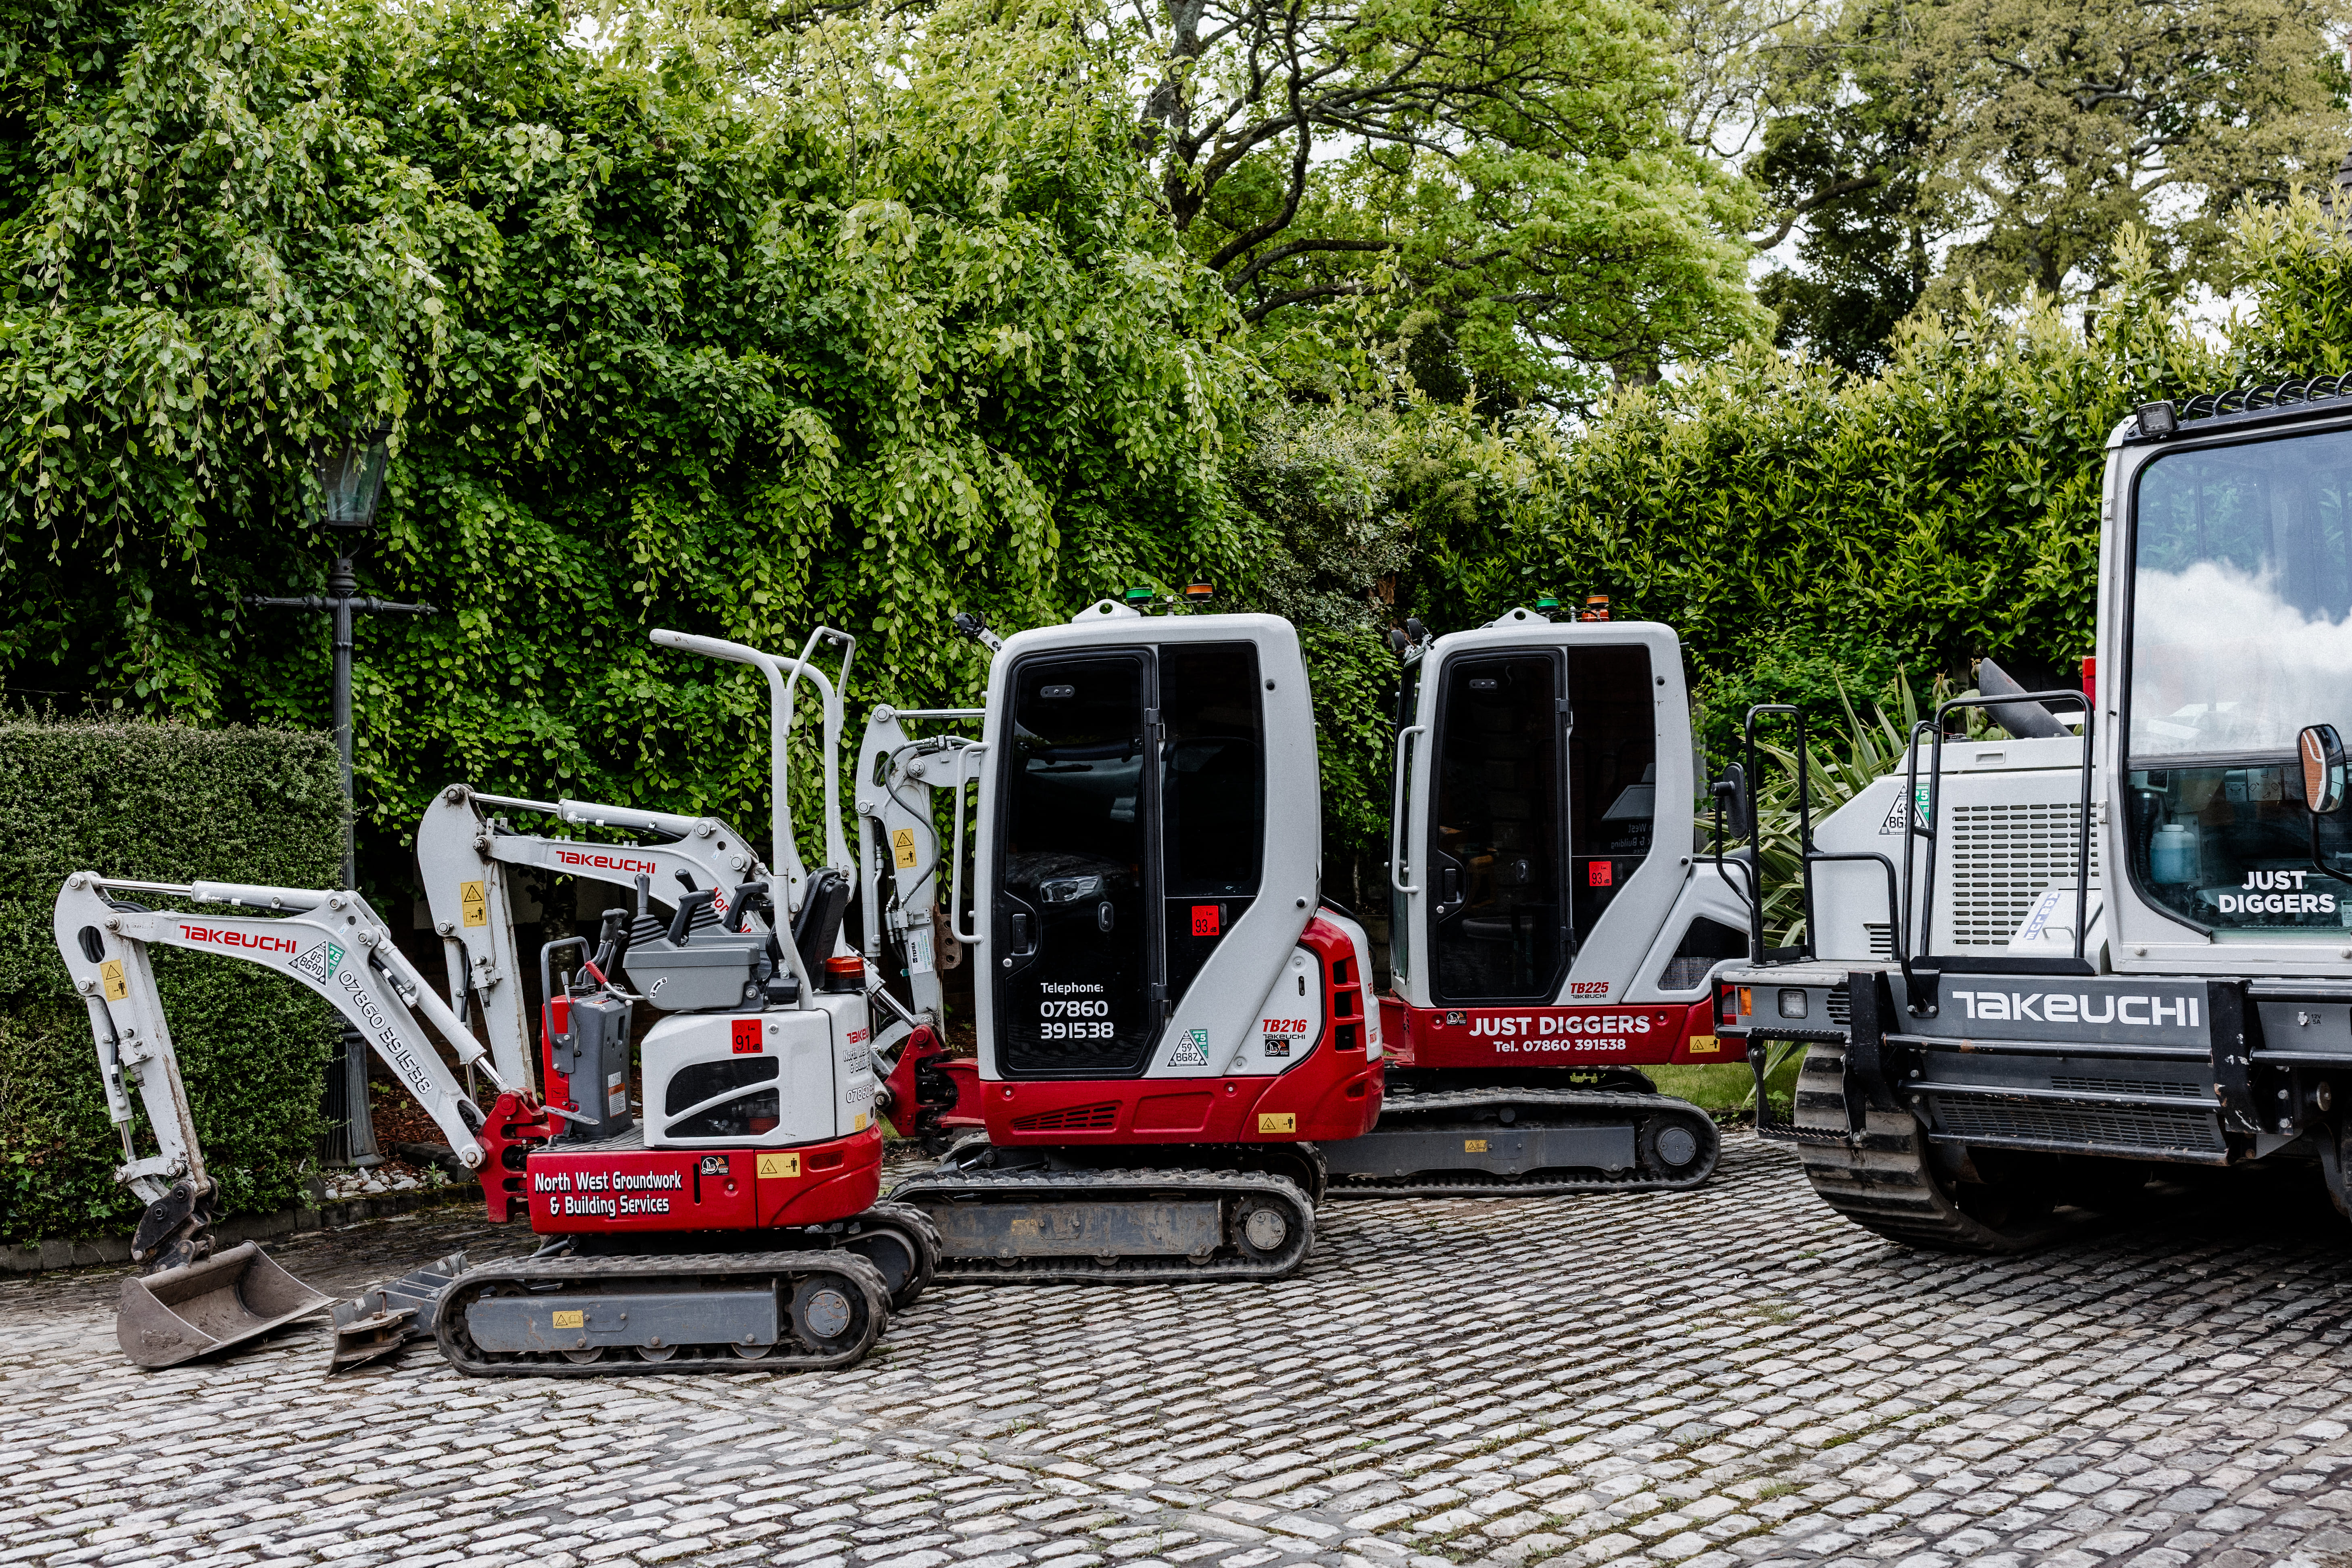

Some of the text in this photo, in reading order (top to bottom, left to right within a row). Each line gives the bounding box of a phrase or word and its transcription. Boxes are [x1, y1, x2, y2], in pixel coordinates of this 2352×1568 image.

[1920, 790, 1928, 800] 5
[1592, 872, 1602, 884] 93
[2241, 871, 2307, 890] JUST
[2218, 894, 2336, 913] DIGGERS
[2025, 892, 2059, 940] ADBLUE
[1196, 919, 1208, 933] 93
[333, 953, 341, 961] 5
[300, 956, 323, 976] BG9D
[1040, 982, 1104, 995] Telephone:
[1570, 982, 1609, 994] TB225
[1040, 1000, 1108, 1017] 07860
[339, 970, 433, 1094] 07860 391538
[1041, 1022, 1114, 1039] 391538
[1263, 1019, 1307, 1033] TB216
[1469, 1015, 1650, 1036] JUST DIGGERS
[735, 1035, 750, 1051] 91
[1181, 1043, 1192, 1052] 59
[1493, 1038, 1626, 1052] Tel. 07860 391538
[843, 1048, 858, 1062] North
[1176, 1052, 1198, 1062] BG8Z
[846, 1084, 869, 1104] 07860
[535, 1170, 682, 1193] North West Groundwork
[549, 1194, 670, 1218] & Building Services
